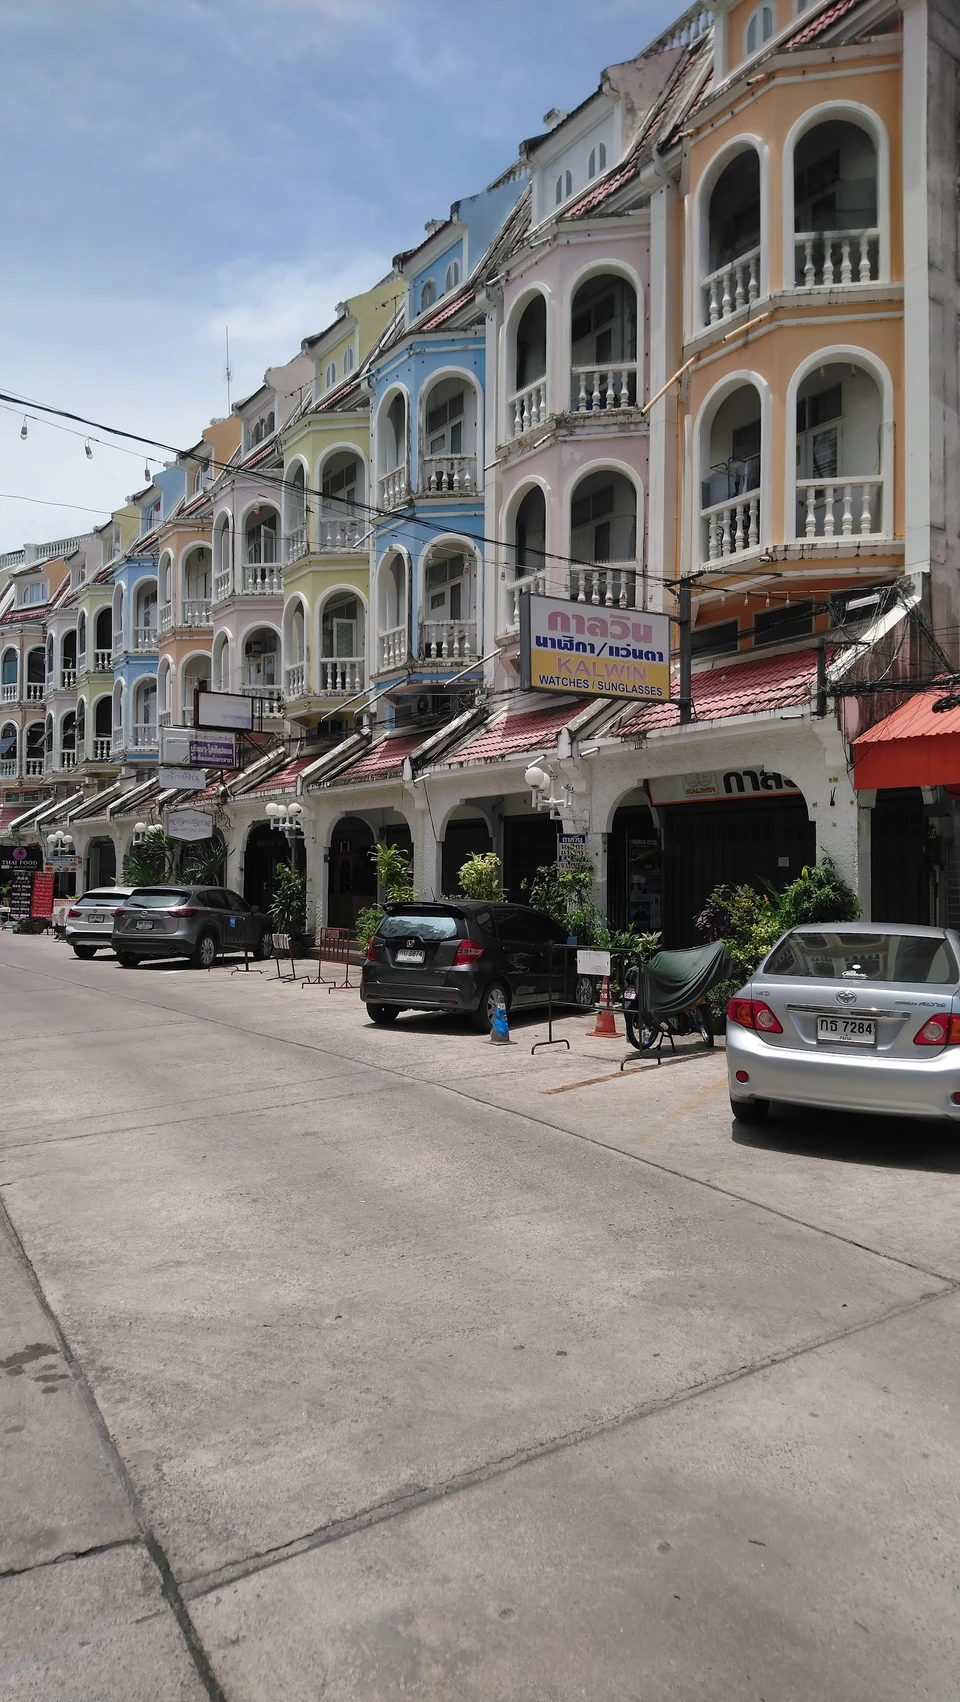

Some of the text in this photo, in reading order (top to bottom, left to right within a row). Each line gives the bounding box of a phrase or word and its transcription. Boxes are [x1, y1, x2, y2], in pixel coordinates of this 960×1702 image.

[548, 611, 652, 644] กาลวิน
[557, 657, 647, 683] KALWIN
[539, 675, 589, 689] WATCHES
[597, 680, 663, 696] SUNGLASSES
[685, 787, 716, 795] KALWIN
[723, 770, 798, 794] กาล
[821, 1020, 872, 1034] กธ 7284
